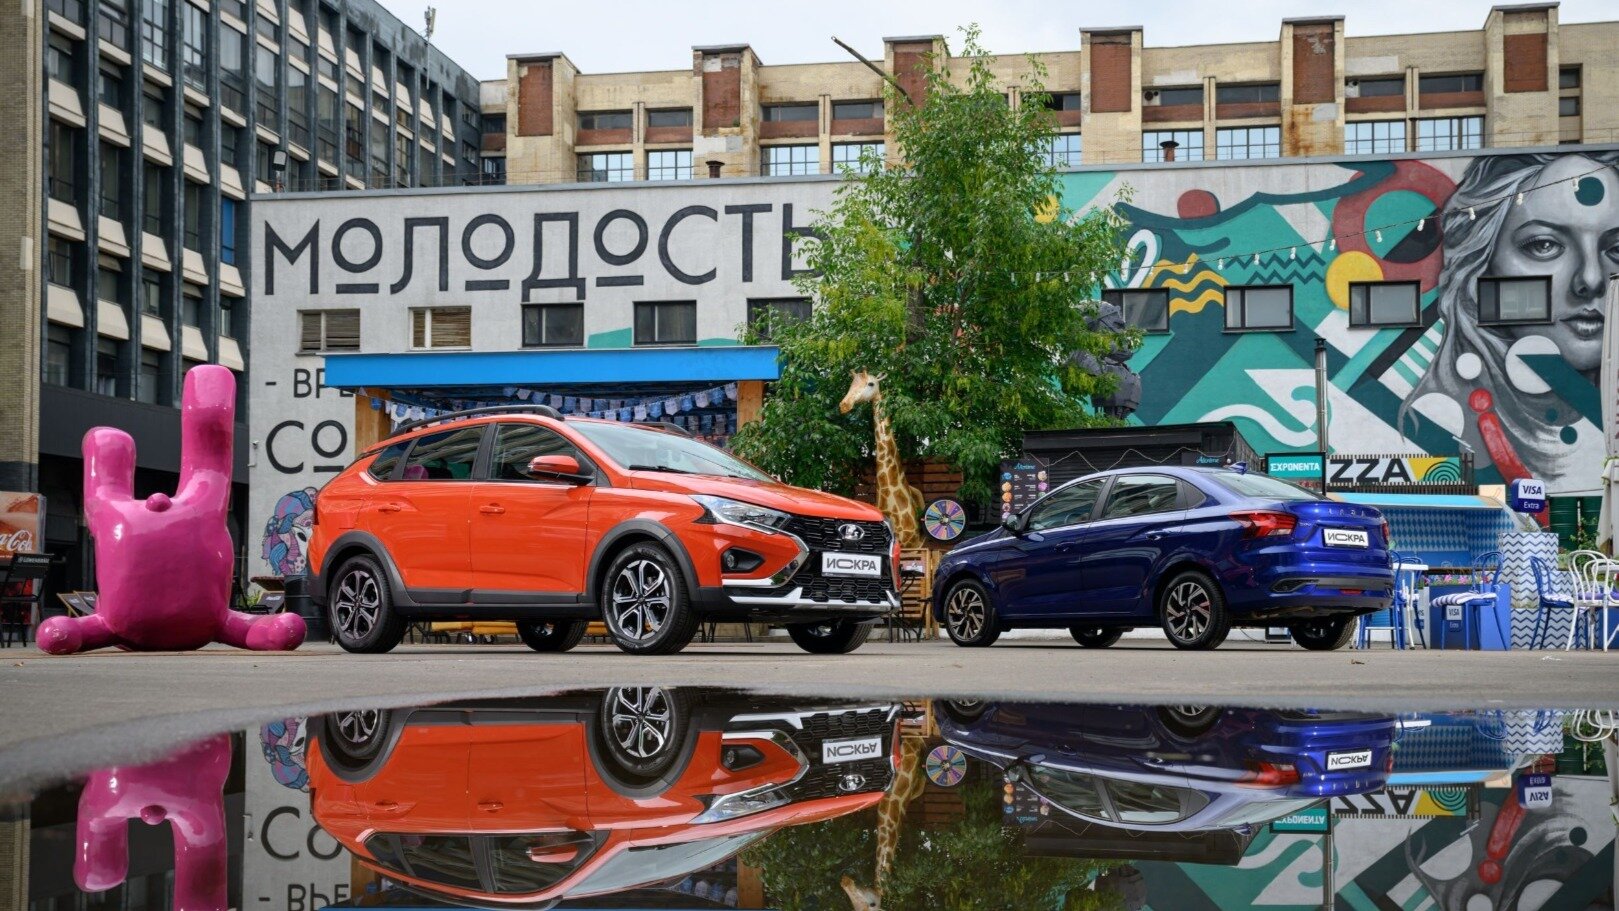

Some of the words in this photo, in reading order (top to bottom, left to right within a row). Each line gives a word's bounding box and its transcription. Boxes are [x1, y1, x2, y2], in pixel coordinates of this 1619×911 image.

[264, 203, 828, 303] МОЛОДОСТЬ
[1270, 462, 1320, 472] EXPONENTA
[1329, 458, 1412, 484] ZZA
[1522, 485, 1542, 495] VISA
[1523, 501, 1540, 510] Extra
[1327, 532, 1366, 543] ИСКРА
[826, 557, 877, 571] ИСКРА
